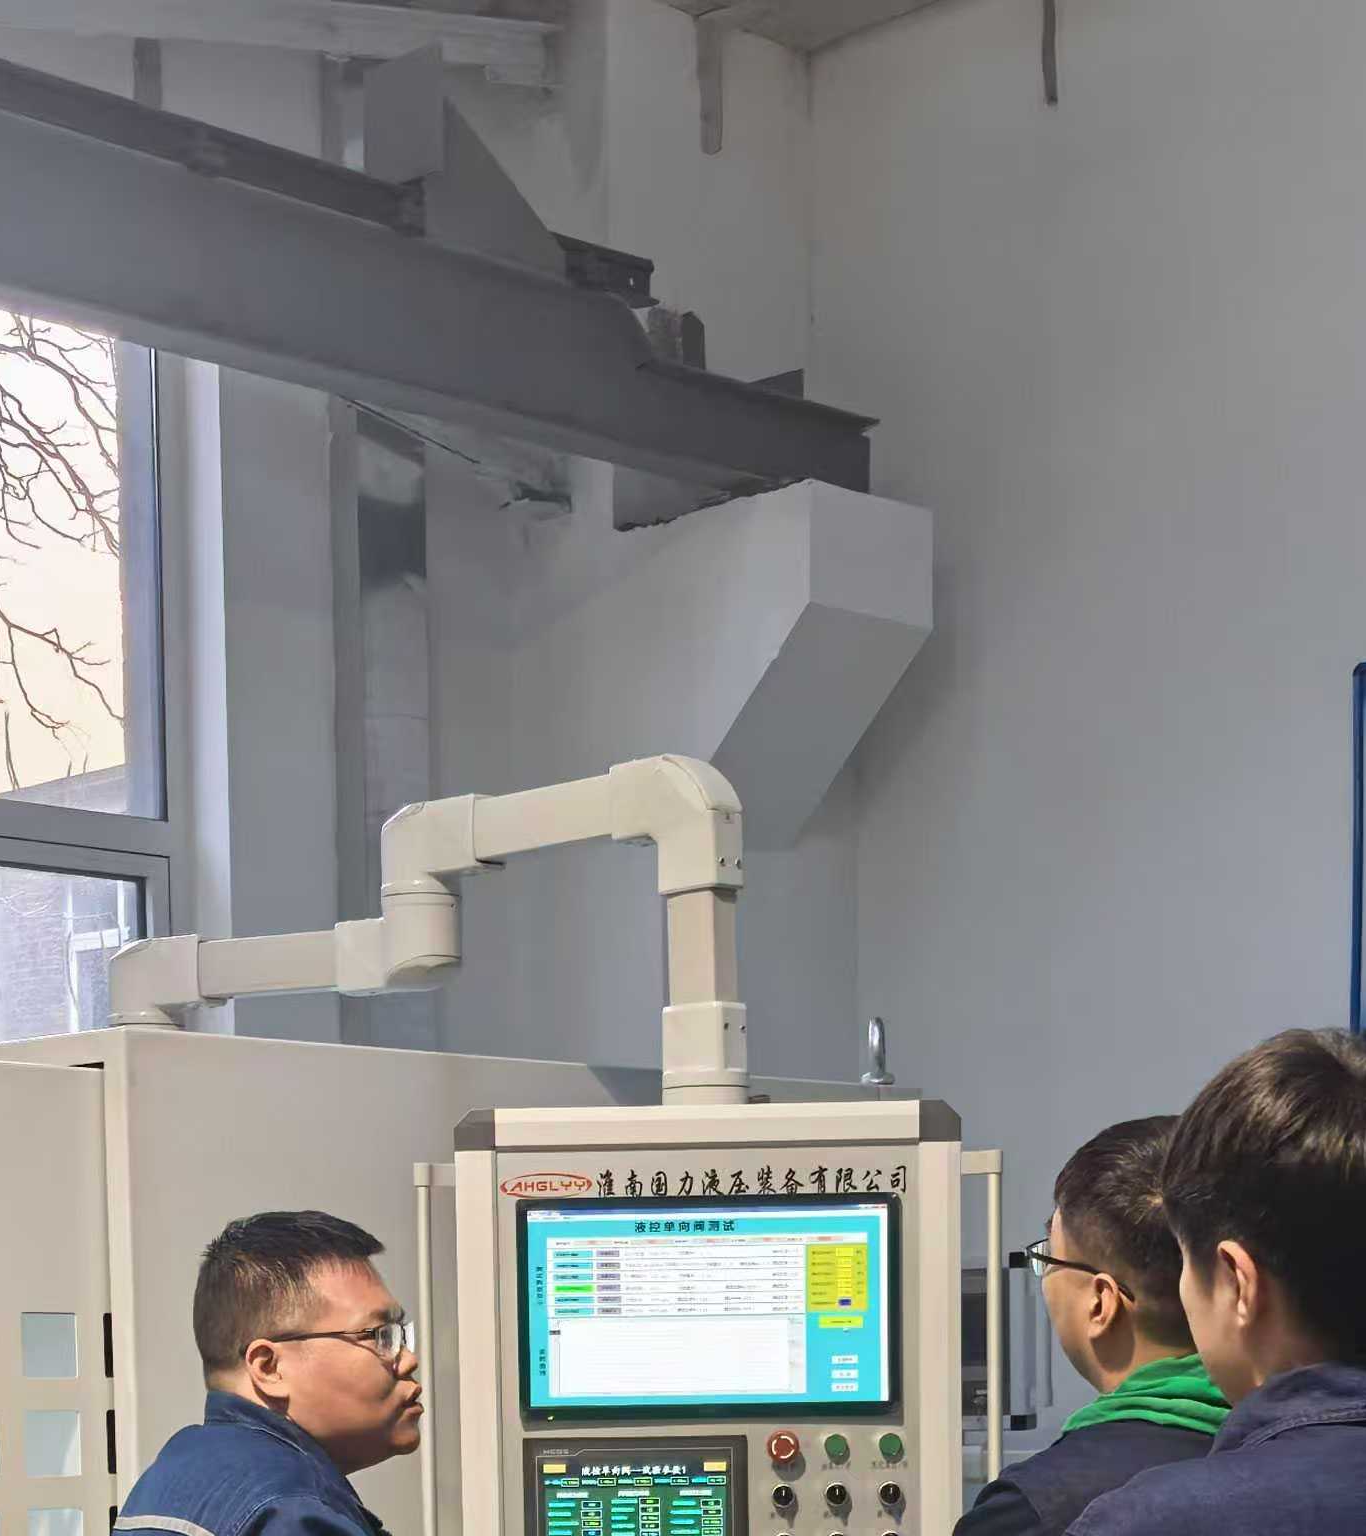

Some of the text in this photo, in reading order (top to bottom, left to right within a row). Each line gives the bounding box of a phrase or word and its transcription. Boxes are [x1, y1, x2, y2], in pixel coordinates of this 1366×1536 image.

[510, 1181, 586, 1194] AHGLYY
[596, 1165, 908, 1197] 淮南国力液压装备有限公司
[635, 1218, 736, 1234] 液控单向阀测试
